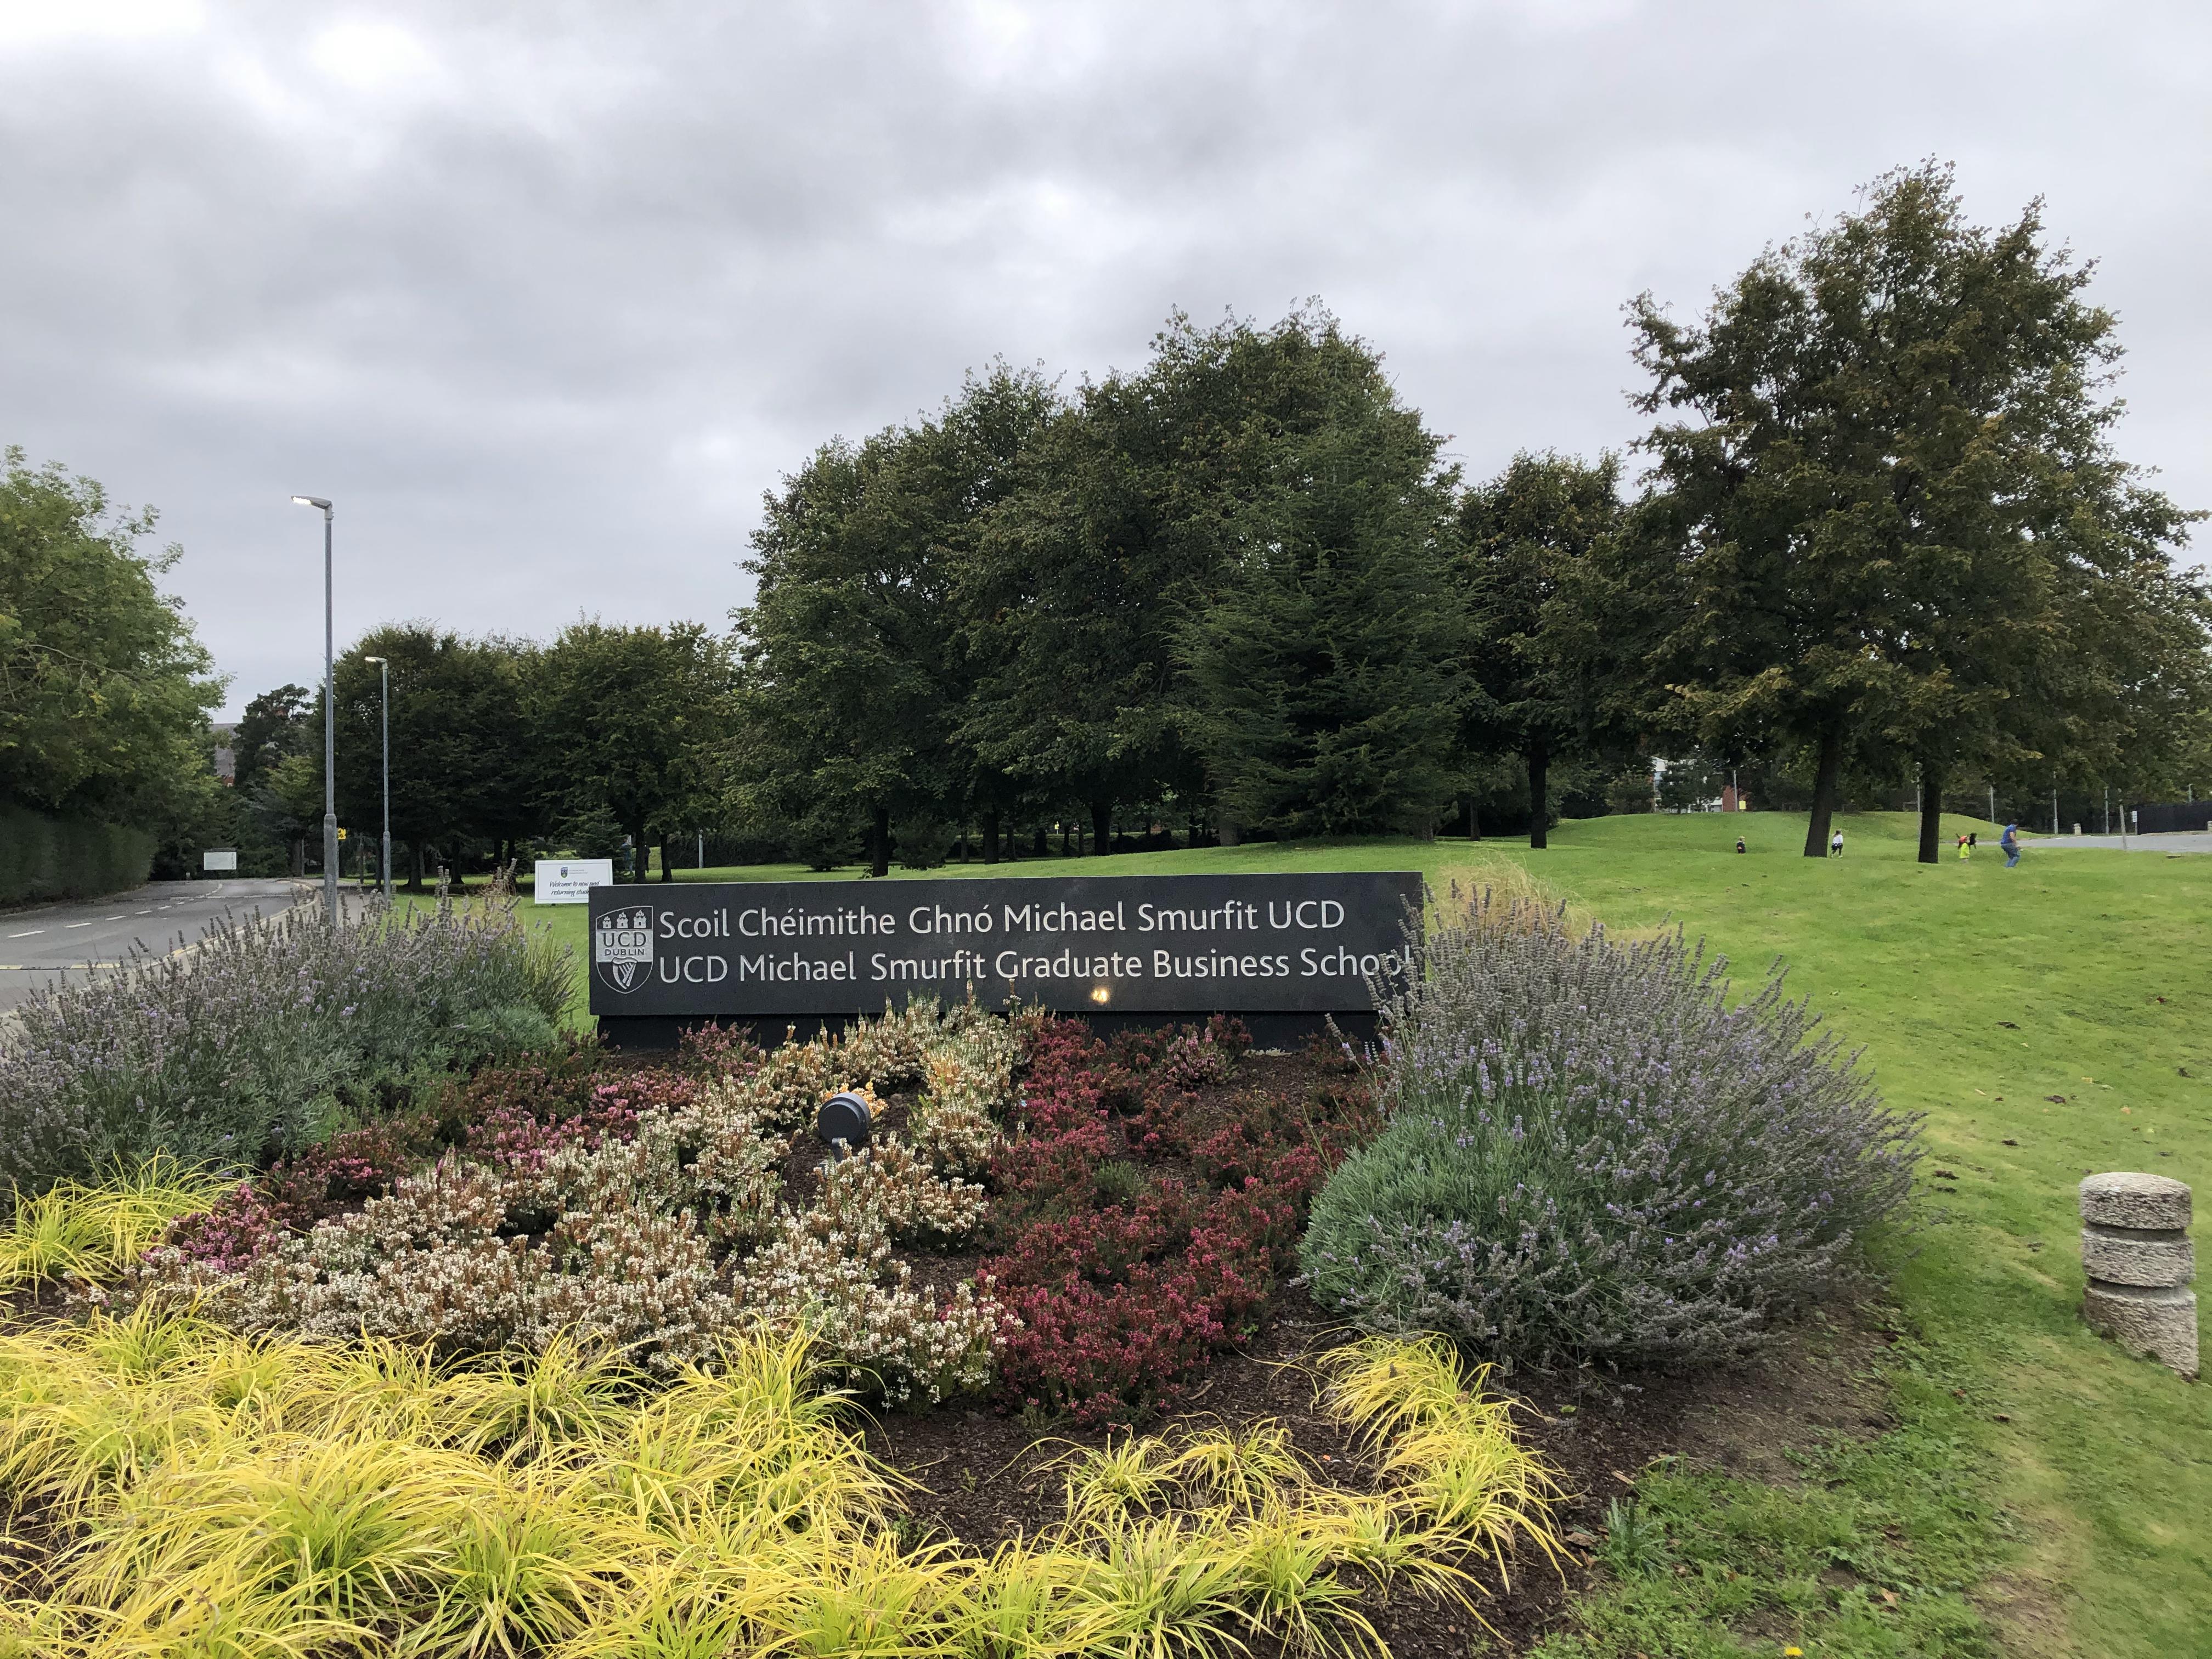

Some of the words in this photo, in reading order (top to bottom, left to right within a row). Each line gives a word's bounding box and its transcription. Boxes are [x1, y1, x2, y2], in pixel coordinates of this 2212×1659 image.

[660, 909, 730, 938] Scoil
[739, 906, 896, 936] Chéimithe
[909, 904, 993, 934] Ghnó
[1005, 901, 1126, 932] Michael
[1138, 900, 1259, 931] Smurfit
[1269, 900, 1345, 929] UCD
[603, 932, 646, 947] UCD
[660, 955, 728, 983] UCD
[740, 951, 856, 981] Michael
[871, 950, 986, 980] Smurfit
[995, 948, 1142, 979] Graduate
[1154, 948, 1290, 978] Business
